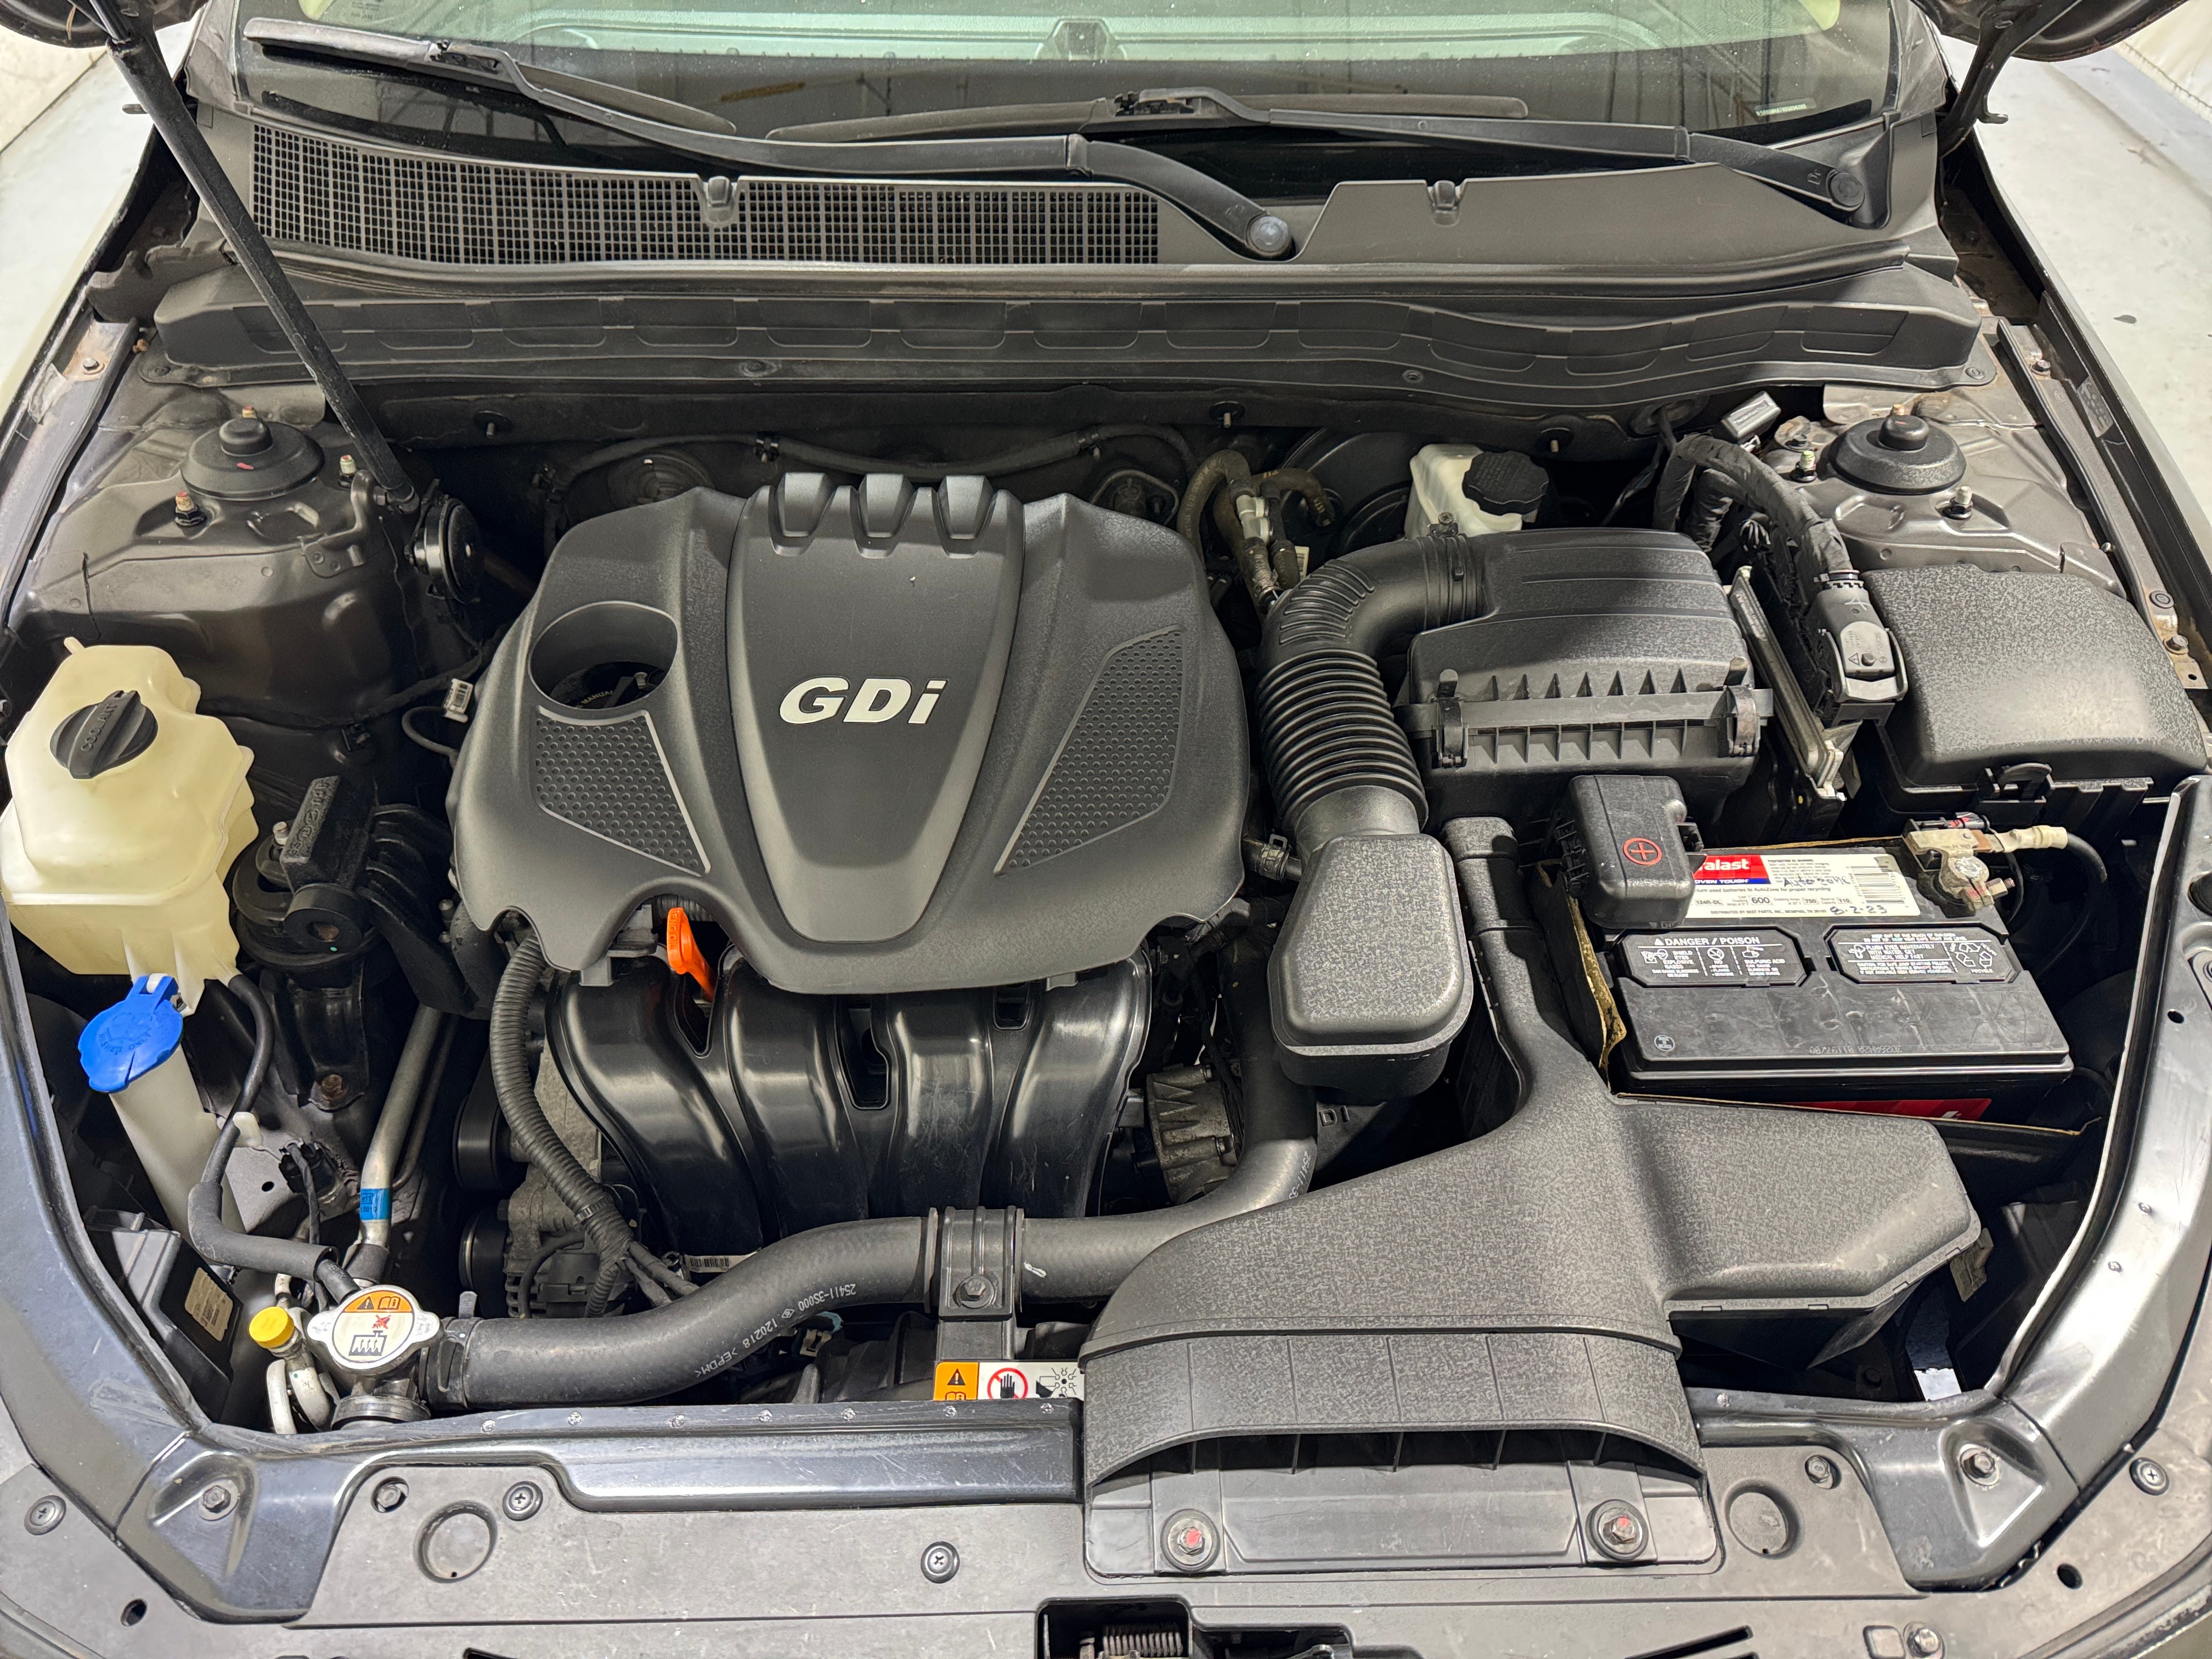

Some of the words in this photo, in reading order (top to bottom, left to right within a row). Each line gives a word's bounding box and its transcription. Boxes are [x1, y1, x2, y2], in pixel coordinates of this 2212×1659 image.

[779, 676, 947, 724] GDi
[81, 703, 117, 751] COOLANT
[669, 912, 678, 932] ENG
[1719, 936, 1760, 945] POISON
[98, 1033, 123, 1055] WASHER
[128, 1031, 151, 1051] ONLY
[742, 1318, 778, 1348] 120218
